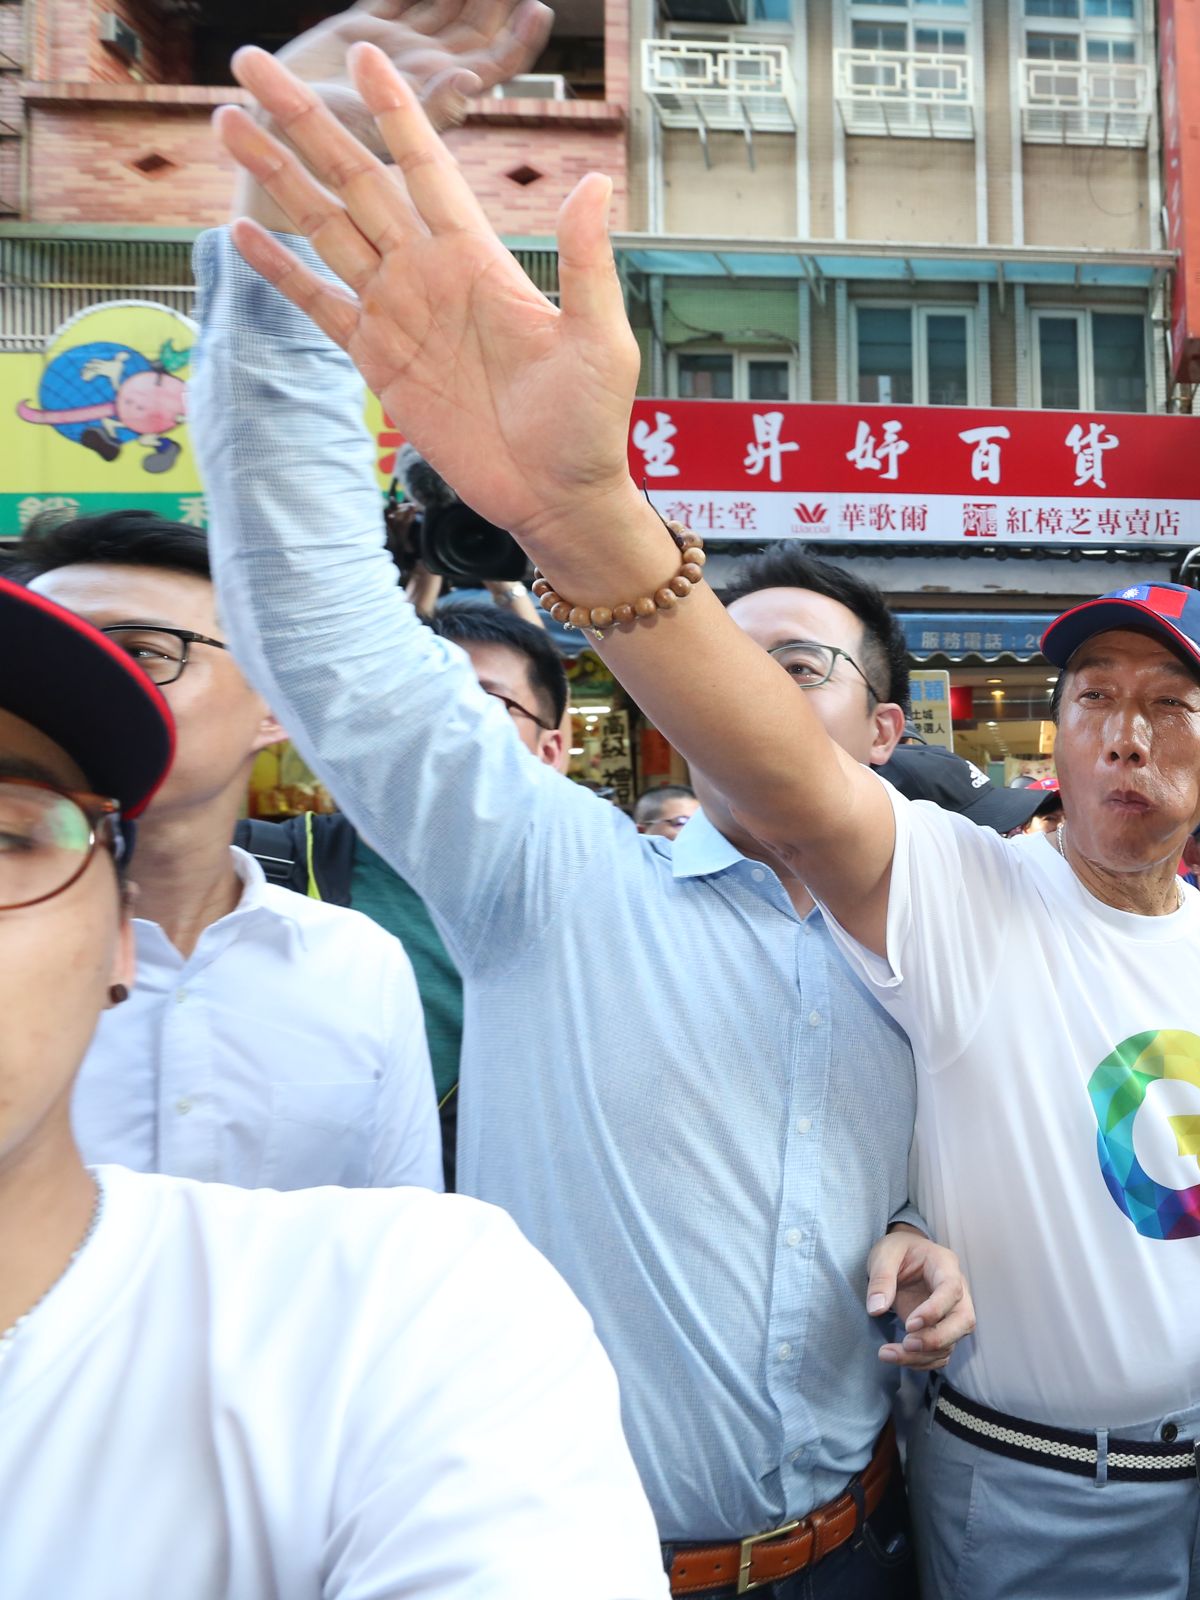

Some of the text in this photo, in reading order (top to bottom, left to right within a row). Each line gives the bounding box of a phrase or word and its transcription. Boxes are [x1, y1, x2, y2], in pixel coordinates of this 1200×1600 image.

[666, 501, 757, 530] 資生堂
[838, 503, 928, 532] 華歌爾
[1006, 506, 1181, 537] 紅樟芝專賣店
